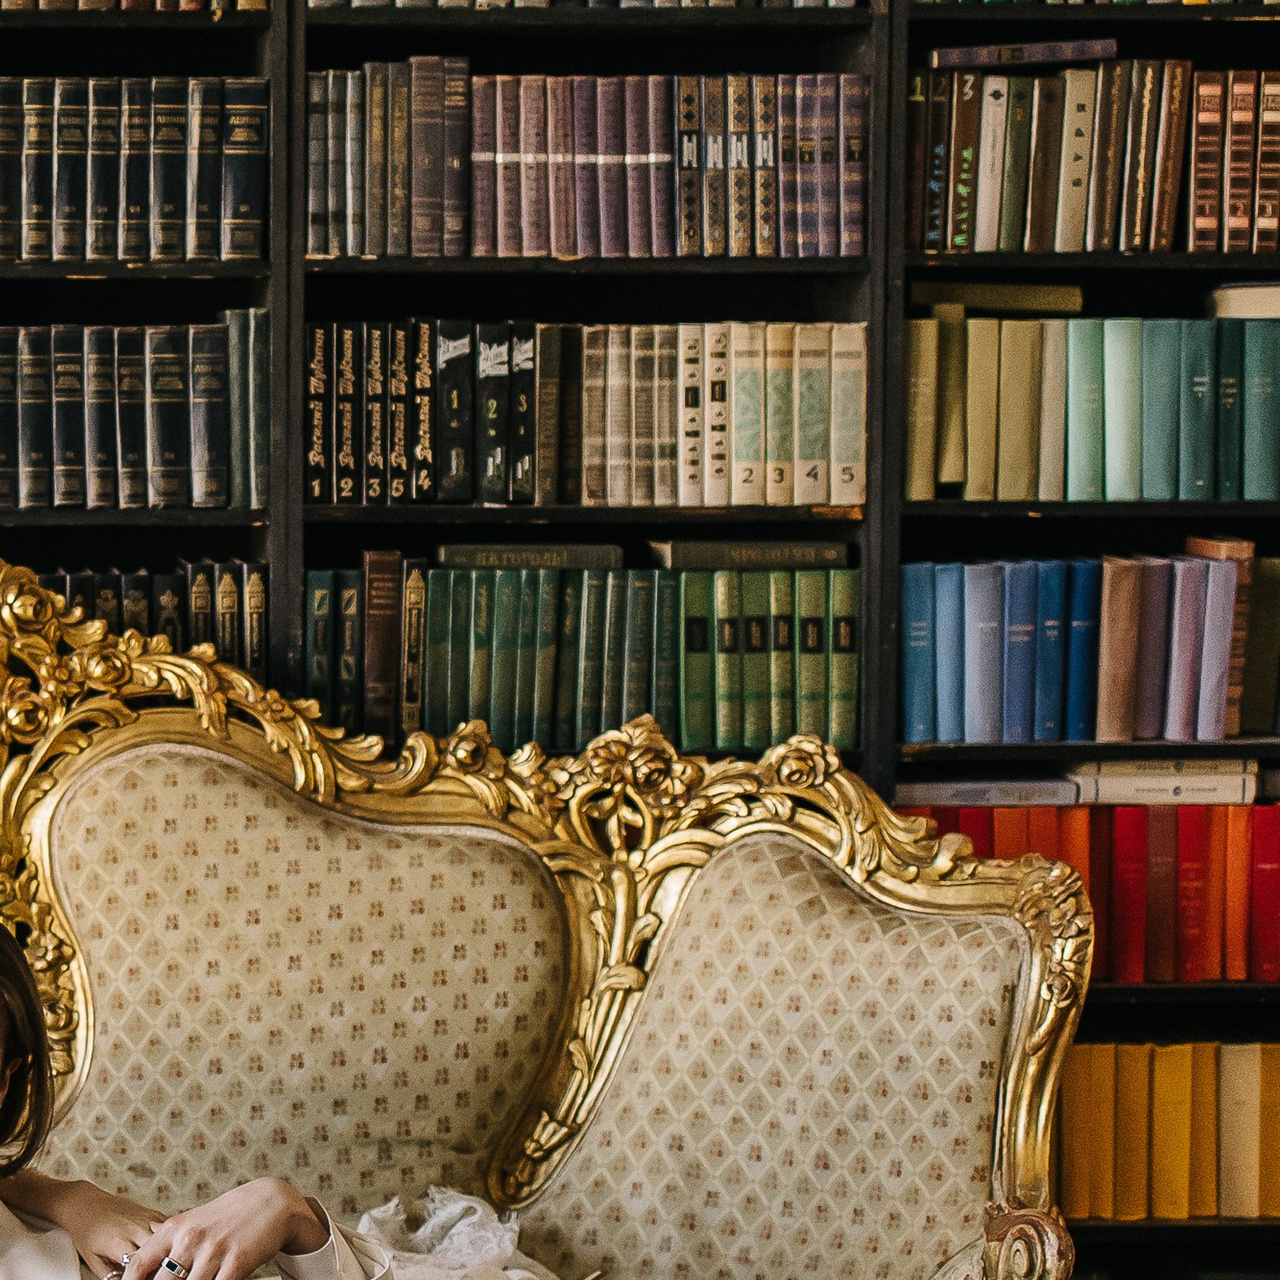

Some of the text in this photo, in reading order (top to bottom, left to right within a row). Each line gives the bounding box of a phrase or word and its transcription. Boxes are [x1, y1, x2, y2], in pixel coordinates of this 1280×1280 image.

[963, 75, 976, 101] 3
[1237, 204, 1245, 216] 2
[1265, 204, 1273, 216] 3
[415, 322, 433, 490] 4 Василий Шукшин
[451, 390, 459, 410] 1
[488, 399, 497, 419] 2
[519, 395, 528, 412] 3
[308, 328, 327, 497] 1 Василий Шукшин
[339, 328, 356, 497] 2 Василий Шукшин
[367, 329, 384, 497] 3 Василий Шукшин
[390, 329, 408, 497] 5 Василий Шукшин
[743, 468, 754, 483] 2
[773, 468, 785, 483] 3
[806, 465, 819, 481] 4
[842, 467, 855, 483] 5
